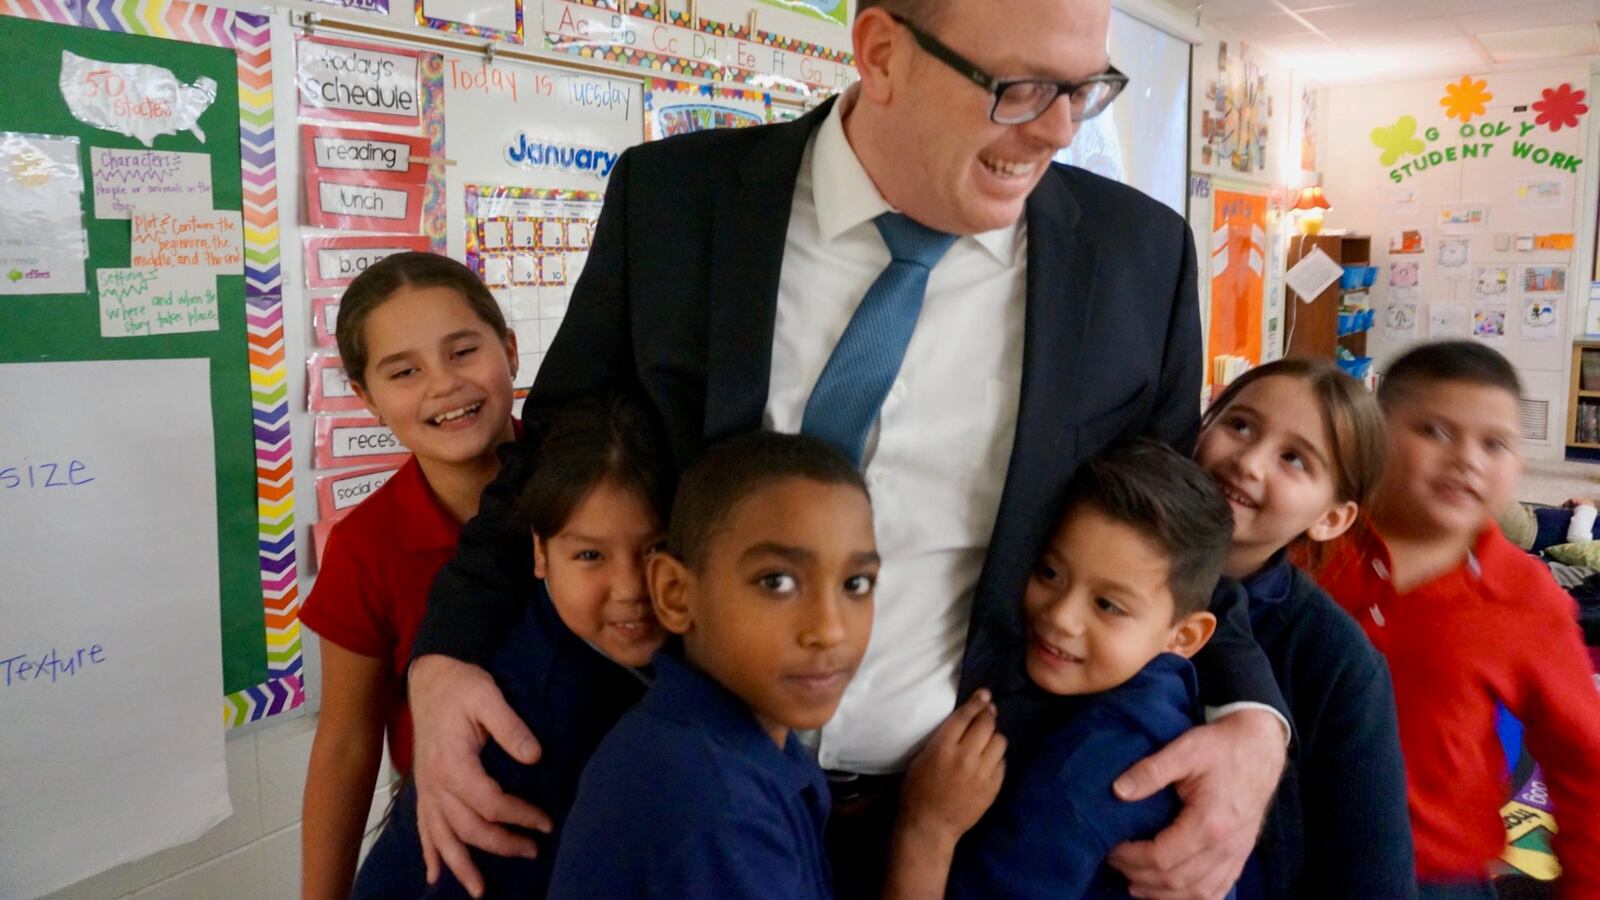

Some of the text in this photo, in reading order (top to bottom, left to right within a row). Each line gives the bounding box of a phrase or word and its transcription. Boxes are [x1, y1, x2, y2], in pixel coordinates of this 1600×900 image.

[652, 25, 678, 53] Cc
[737, 42, 756, 69] Ee
[321, 51, 394, 81] today's
[85, 69, 126, 97] 50
[448, 60, 517, 102] Today
[561, 74, 631, 121] Tuesday
[327, 143, 397, 168] reading
[509, 133, 618, 177] January
[1389, 140, 1583, 183] STUDENT WORK
[341, 188, 384, 211] lunch
[217, 216, 235, 232] the
[177, 251, 199, 265] and
[349, 433, 403, 450] reces
[337, 480, 371, 500] social
[0, 644, 106, 686] Texture
